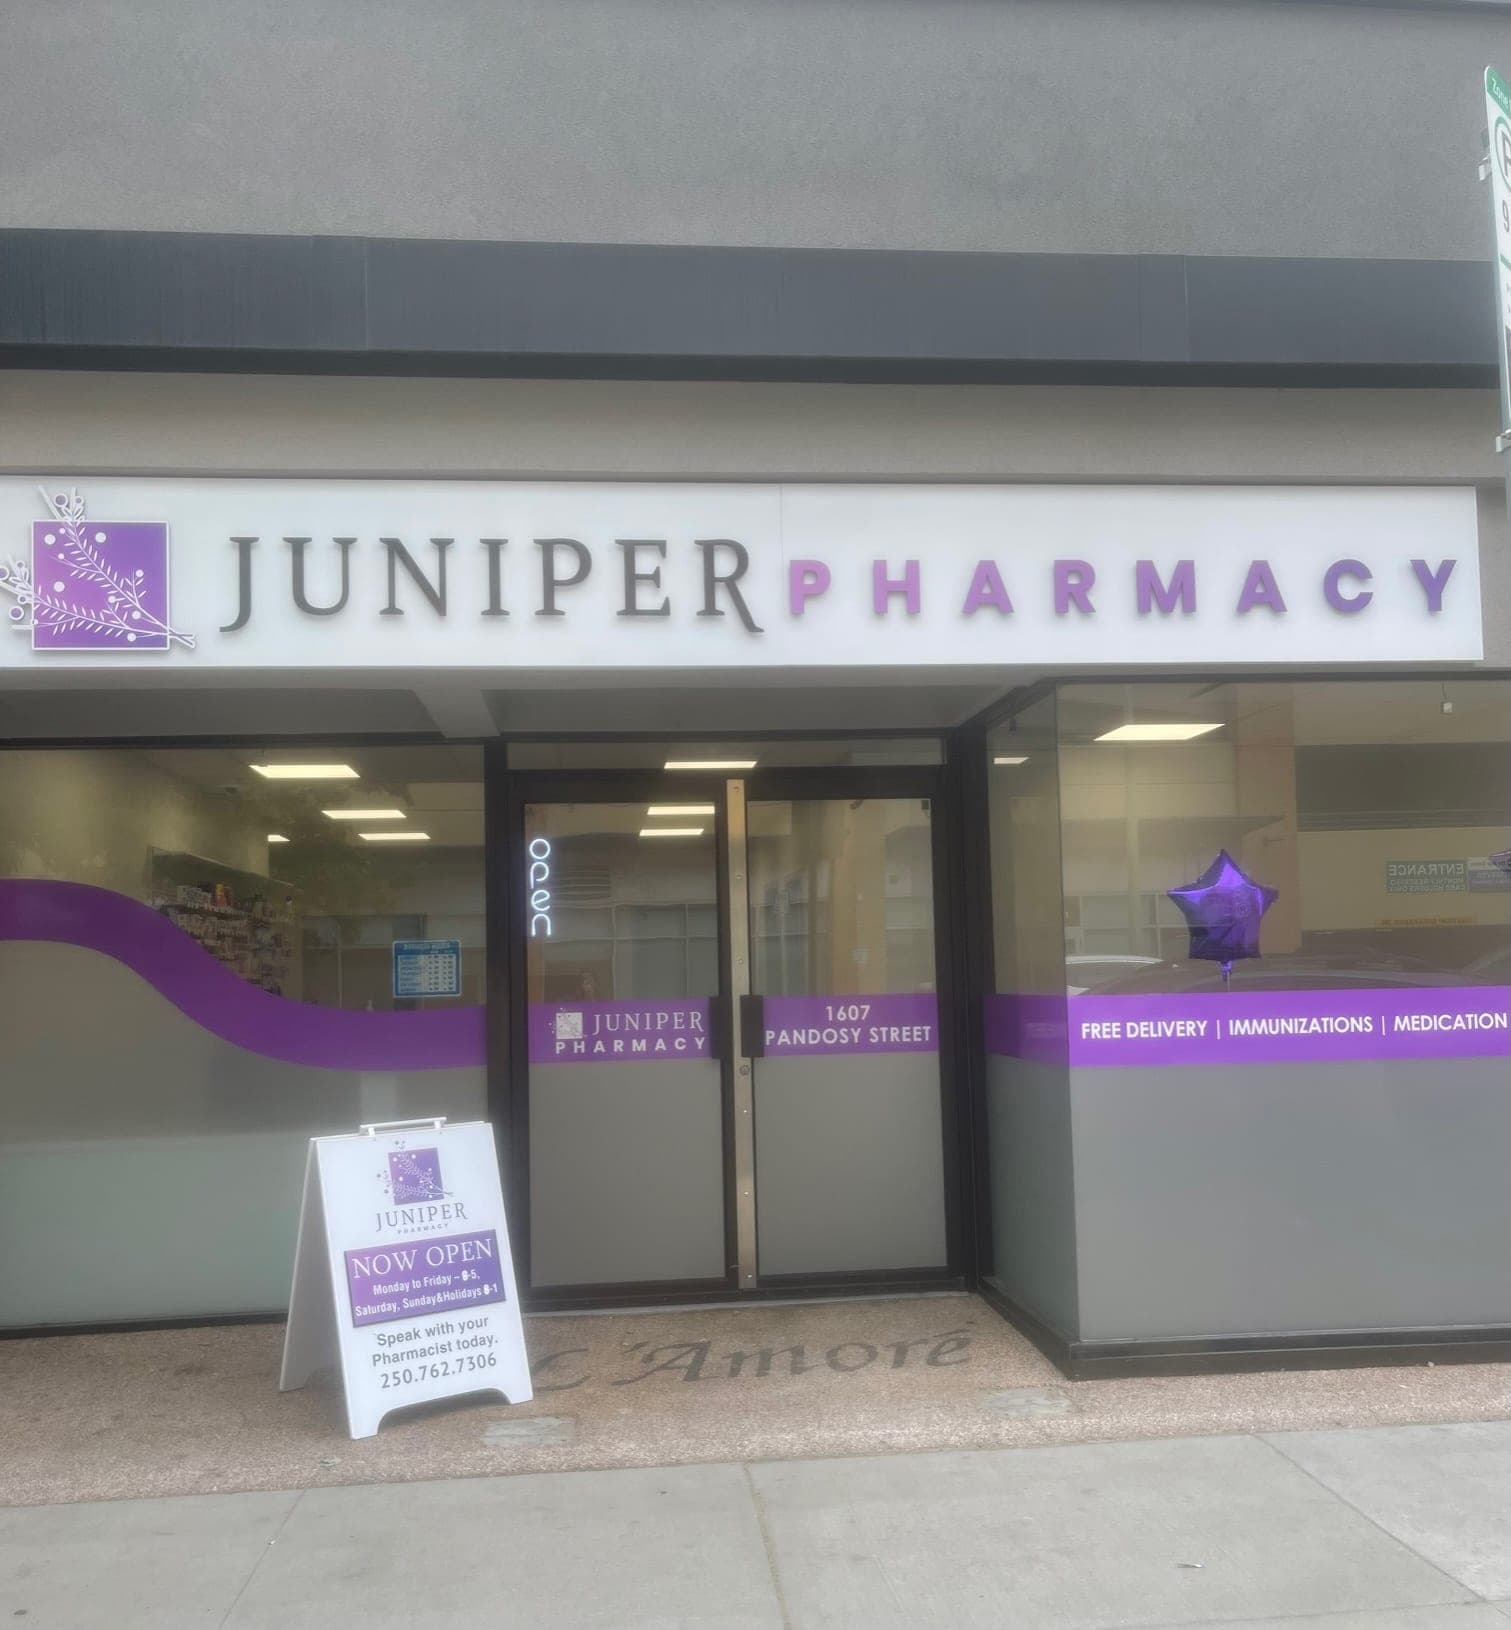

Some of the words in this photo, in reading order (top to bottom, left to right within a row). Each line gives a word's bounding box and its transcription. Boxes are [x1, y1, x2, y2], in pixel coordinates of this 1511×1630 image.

[219, 536, 764, 634] JUNIPER
[789, 558, 1458, 617] PHARMACY
[529, 838, 552, 937] open
[592, 1011, 704, 1036] JUNIPER
[826, 1004, 871, 1022] 1607
[1081, 1022, 1121, 1039] FREE
[1126, 1020, 1208, 1038] DELIVERY
[1228, 1016, 1374, 1036] IMMUNIZATIONS
[1393, 1012, 1509, 1032] MEDICATION
[555, 1036, 705, 1055] PHARMACY
[765, 1027, 862, 1046] PANDOSY
[869, 1025, 932, 1044] STREET
[376, 1202, 468, 1232] JUNIPER
[397, 1223, 449, 1235] PHARMACY
[352, 1249, 418, 1279] NOW
[426, 1238, 493, 1267] OPEN
[372, 1281, 410, 1296] Monday
[412, 1279, 422, 1290] to
[424, 1274, 451, 1288] Friday
[402, 1285, 482, 1310] Sunday&Holidays
[376, 1328, 422, 1348] Speak
[425, 1322, 455, 1338] with
[457, 1317, 489, 1335] your
[371, 1340, 453, 1368] Pharmacist
[456, 1334, 499, 1352] today.
[380, 1351, 498, 1389] 250.762.7306
